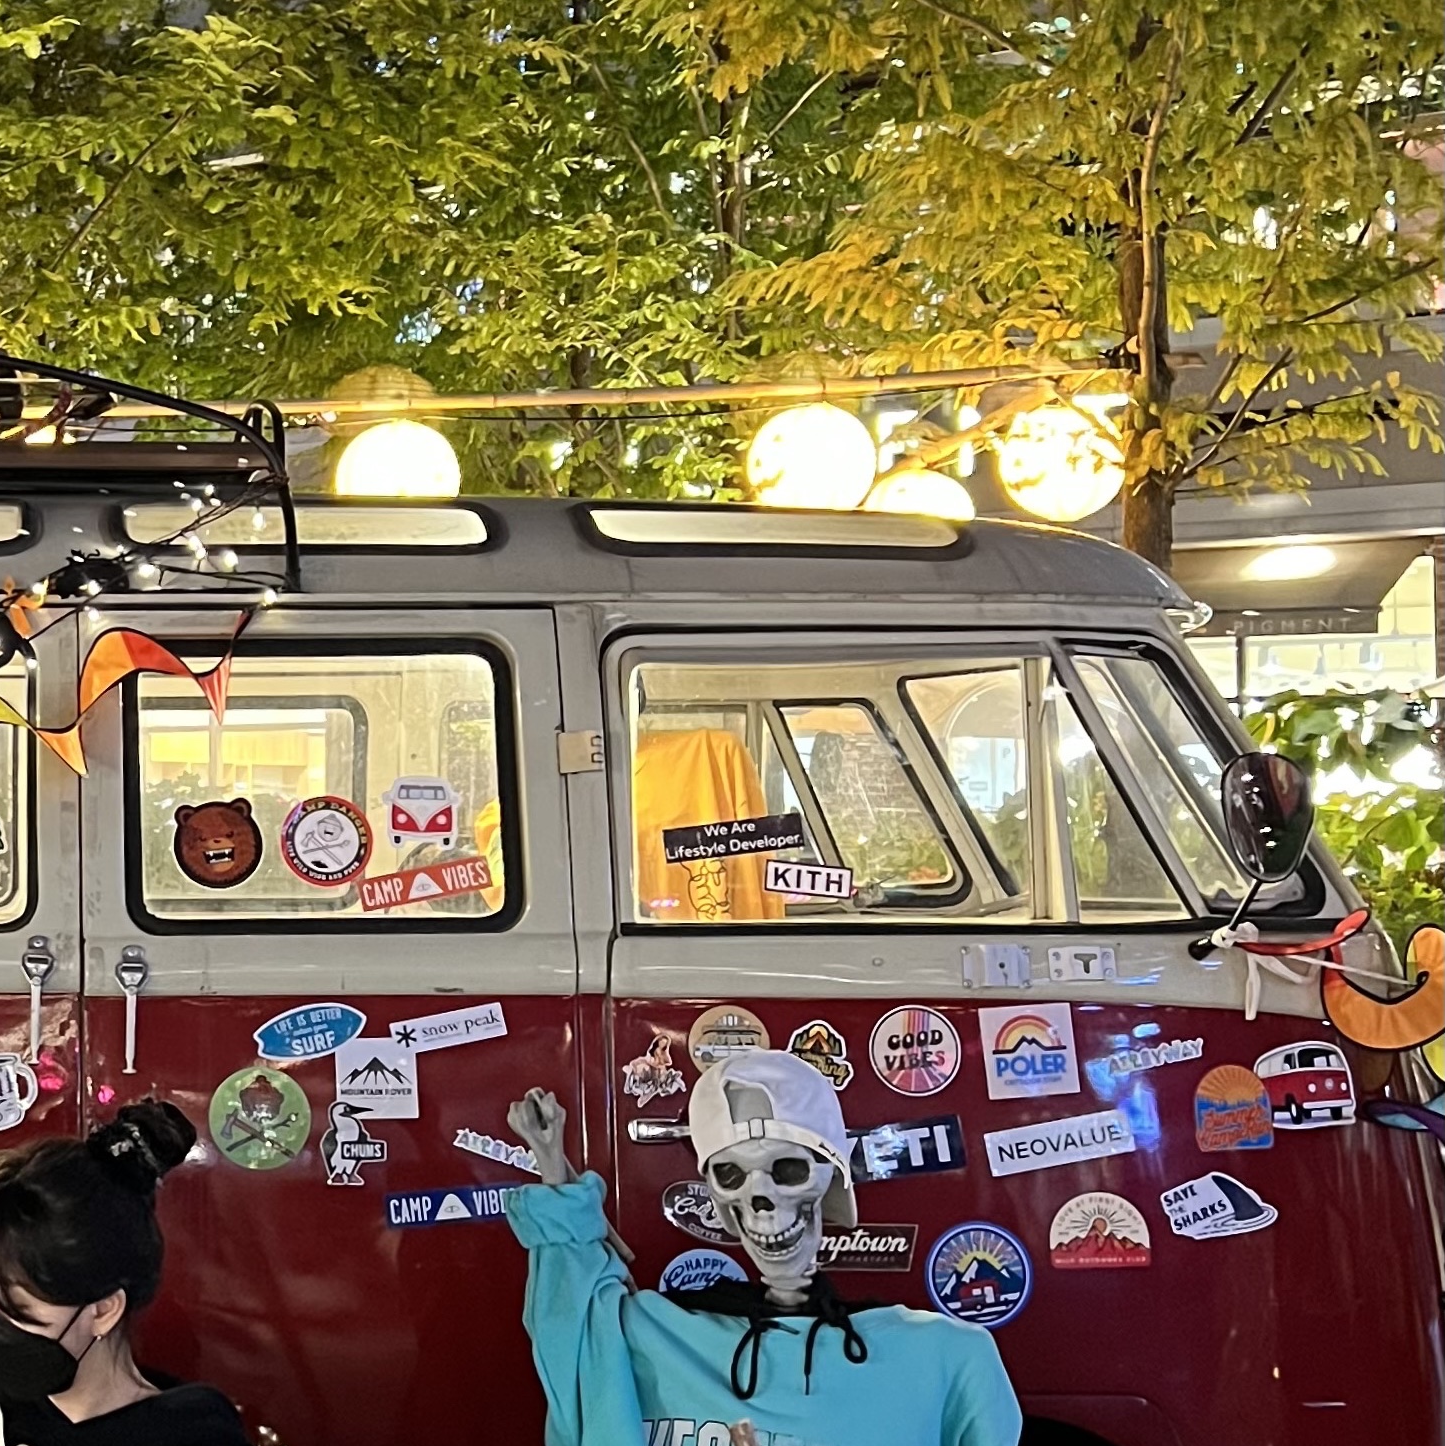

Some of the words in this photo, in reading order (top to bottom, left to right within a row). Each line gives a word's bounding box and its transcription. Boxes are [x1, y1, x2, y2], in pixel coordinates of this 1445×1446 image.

[1233, 617, 1351, 634] PIGMENT
[704, 824, 728, 838] We
[730, 822, 756, 835] Are
[665, 841, 726, 861] Lifestyle
[362, 876, 405, 907] CAMP
[440, 860, 489, 891] VIBES
[773, 867, 843, 893] KITH
[296, 1013, 307, 1027] IS
[421, 1022, 460, 1037] snow
[463, 1009, 501, 1034] peak
[291, 1030, 335, 1056] SURF
[887, 1029, 943, 1051] GOOD
[884, 1050, 946, 1072] VIBES
[995, 1053, 1067, 1078] POLER
[340, 1088, 383, 1096] MOUNTAIN
[342, 1143, 382, 1159] CHUMS
[997, 1124, 1122, 1164] NEOVALUE
[1163, 1184, 1198, 1207] SAVE
[389, 1195, 432, 1225] CAMP
[1173, 1199, 1227, 1231] SHARKS
[684, 1257, 728, 1272] HAPPY
